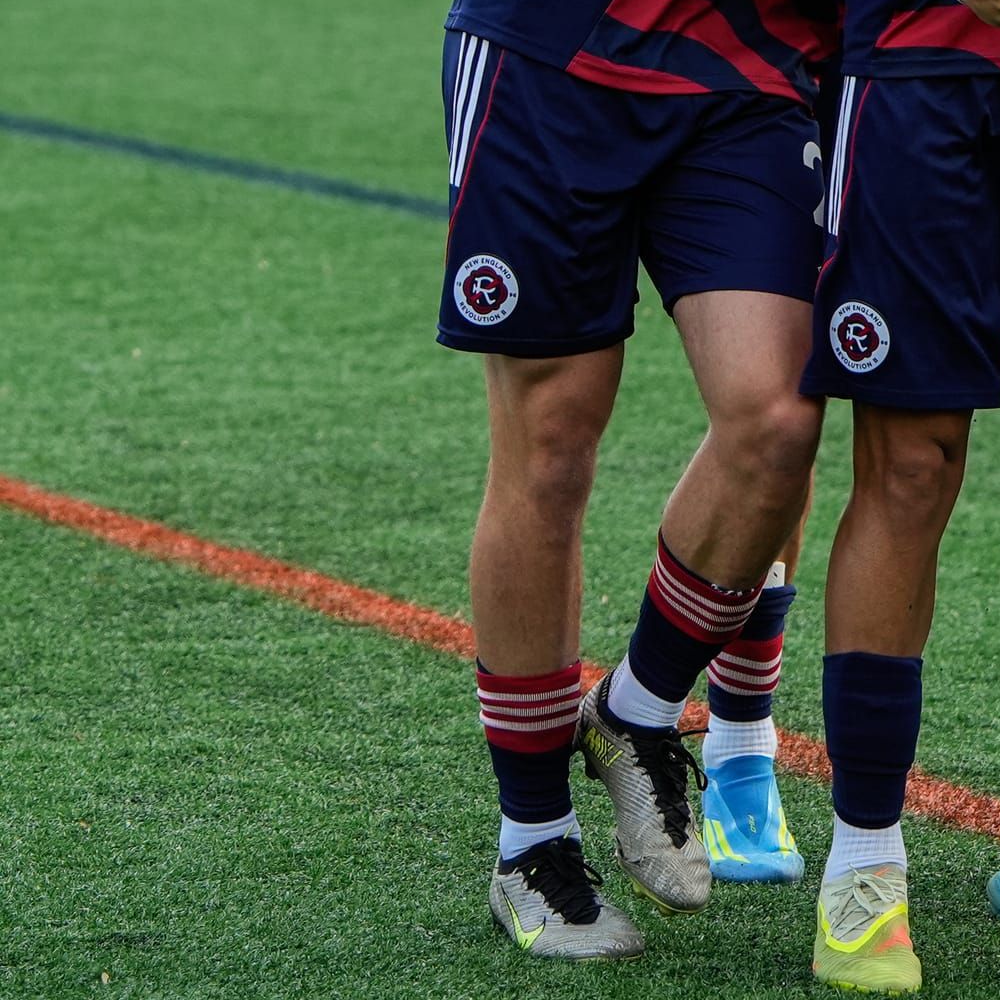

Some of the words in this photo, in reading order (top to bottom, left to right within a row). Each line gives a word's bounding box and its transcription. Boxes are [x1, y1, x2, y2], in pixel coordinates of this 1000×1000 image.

[465, 258, 479, 270] NEW
[481, 257, 512, 280] ENGLAND
[459, 302, 501, 322] REVOLUTION
[838, 305, 851, 316] NEW
[852, 304, 883, 327] ENGLAND
[835, 347, 873, 369] REVOLUTION
